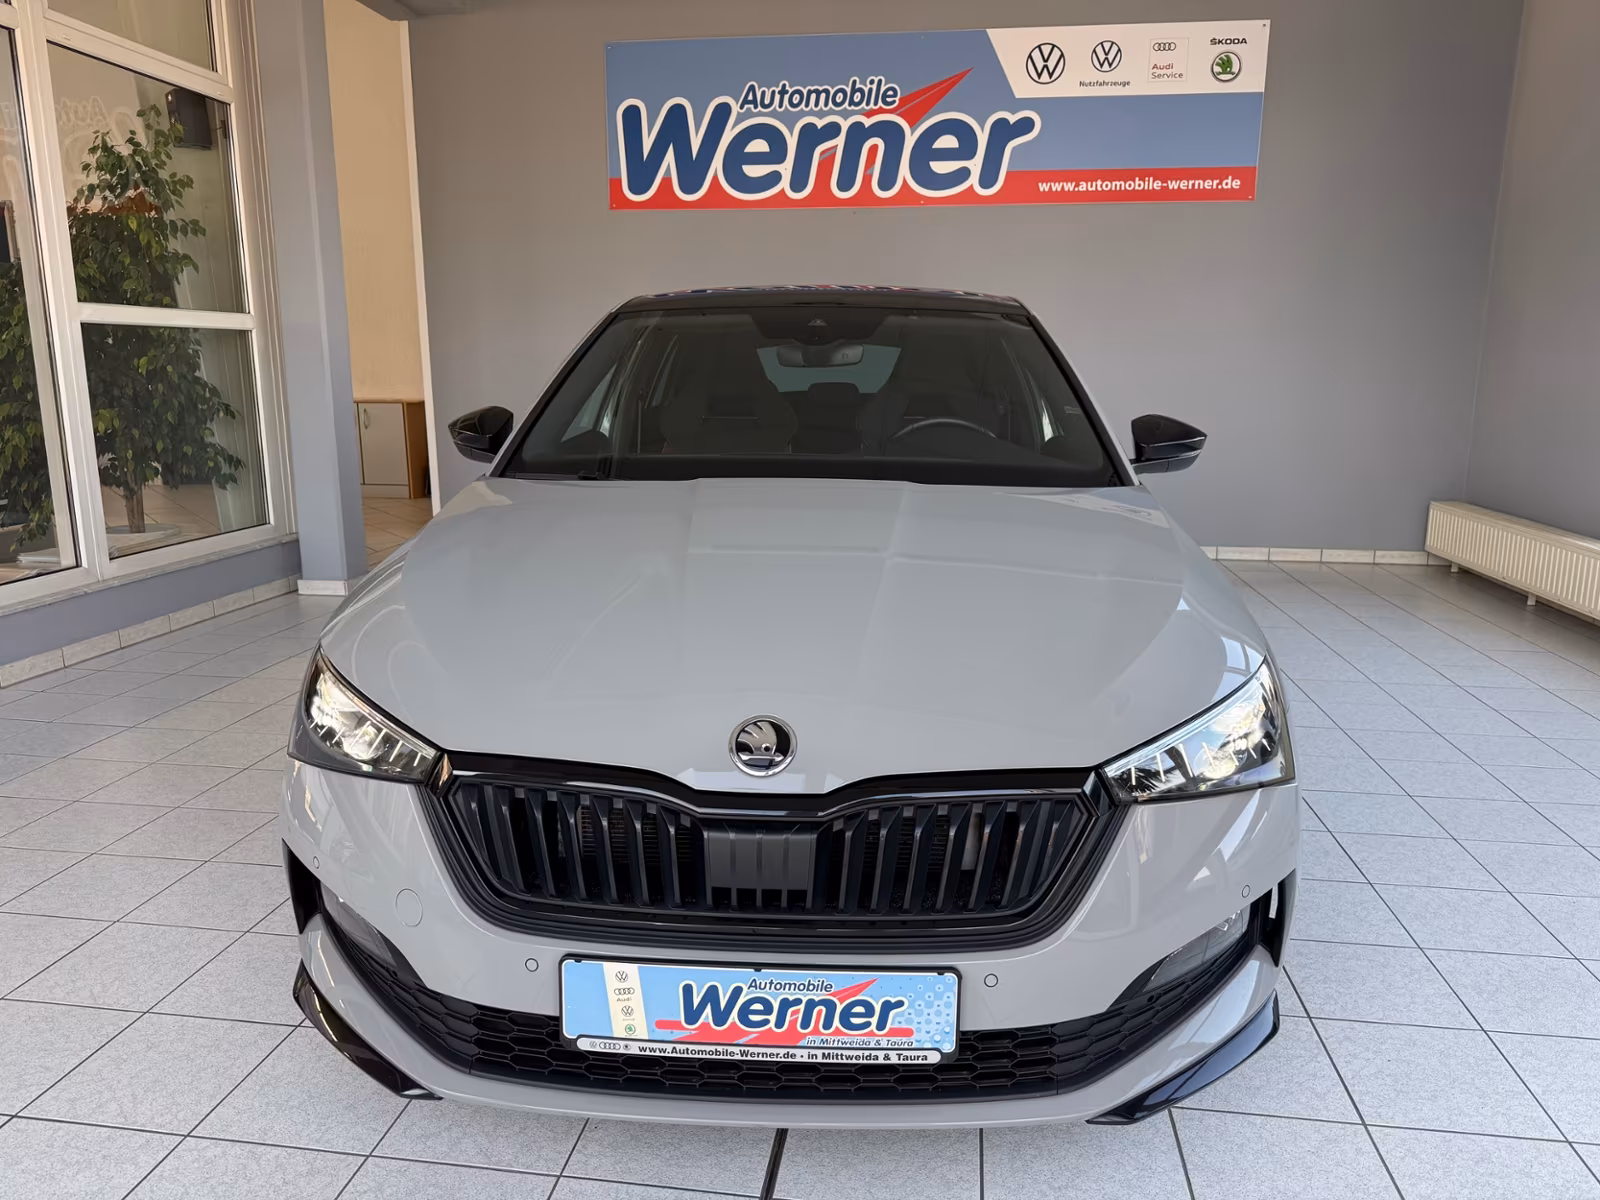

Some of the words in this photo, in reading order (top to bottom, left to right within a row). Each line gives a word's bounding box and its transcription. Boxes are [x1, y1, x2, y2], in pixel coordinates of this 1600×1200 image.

[1209, 37, 1247, 45] ŠKODA
[1151, 62, 1174, 71] Audi
[1079, 79, 1131, 88] Nutzfahrzeuge
[1151, 71, 1183, 80] Service
[738, 77, 900, 113] Automobile
[617, 98, 1041, 201] Werner
[1038, 175, 1241, 193] www.automobile-werner.de
[747, 977, 833, 993] Automobile
[680, 981, 905, 1034] Werner
[806, 1037, 816, 1046] in
[819, 1038, 871, 1047] Mittweida
[874, 1039, 882, 1047] &
[638, 1045, 797, 1060] www.Automobile-Werner.de
[807, 1051, 818, 1060] in
[821, 1052, 879, 1061] Mittweida
[883, 1053, 892, 1061] &
[896, 1053, 928, 1062] Taura
